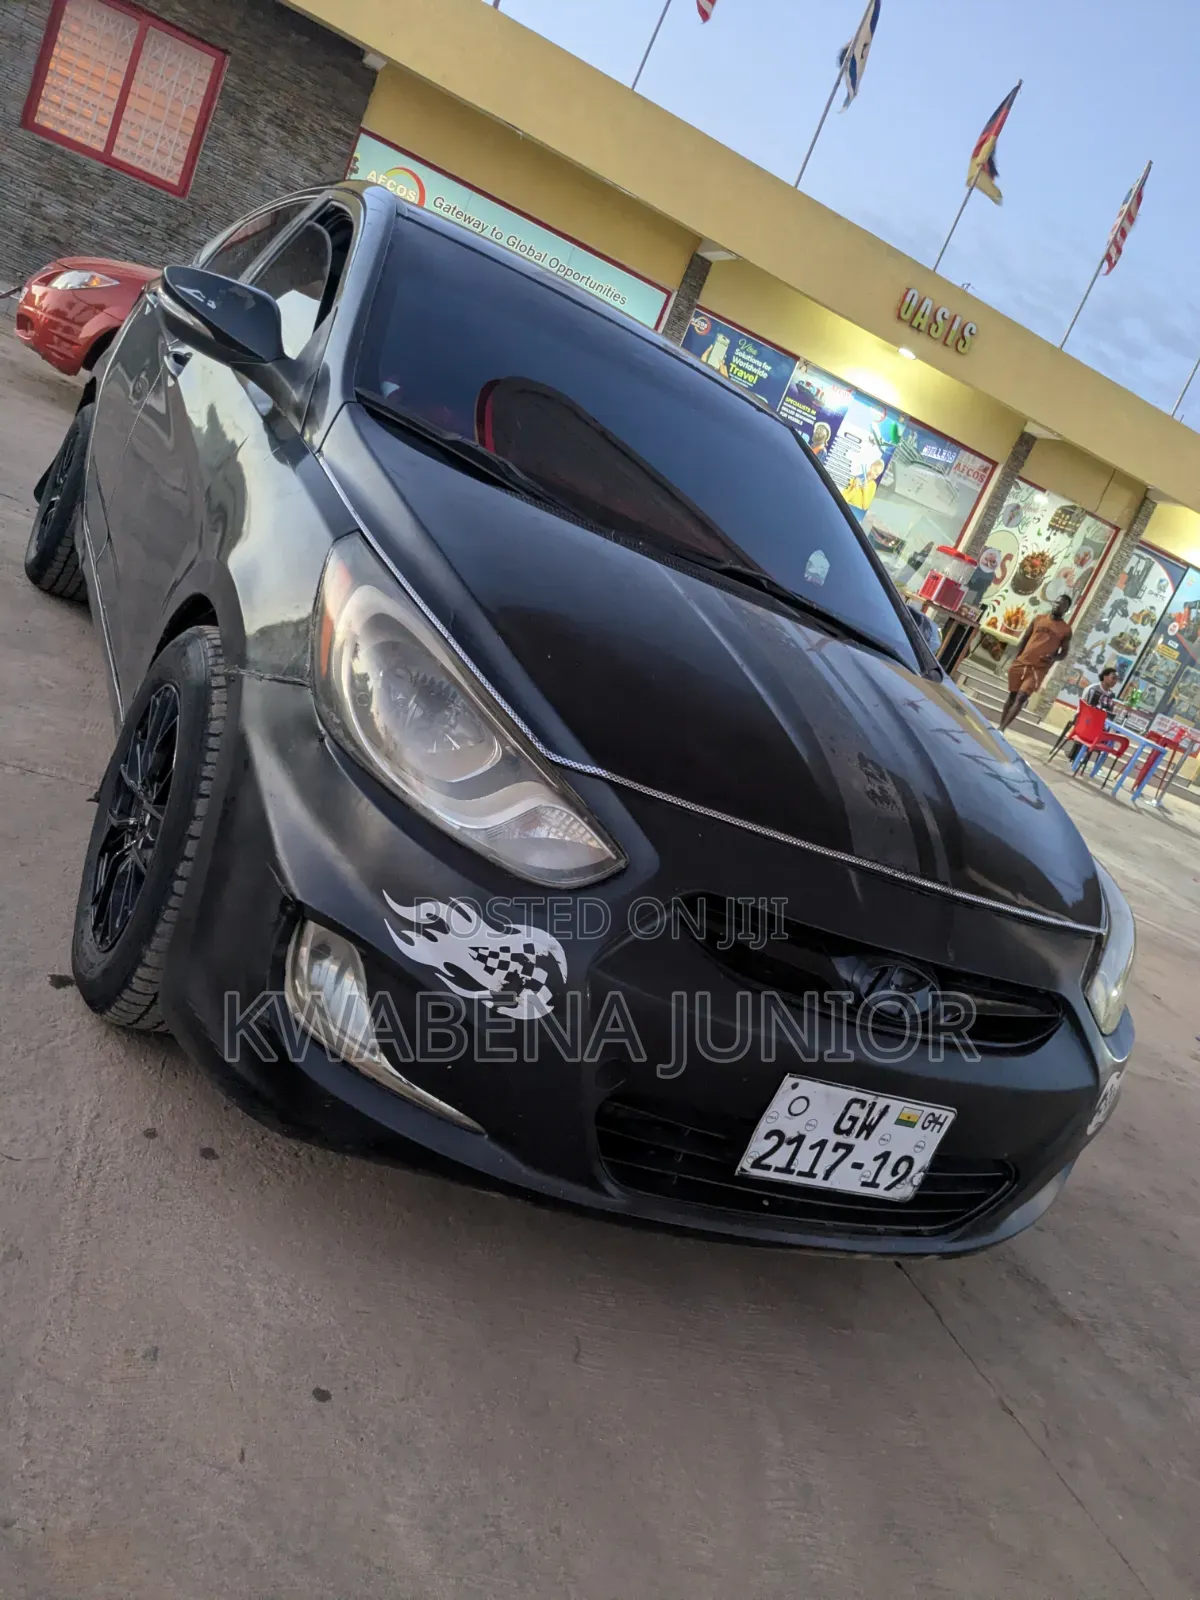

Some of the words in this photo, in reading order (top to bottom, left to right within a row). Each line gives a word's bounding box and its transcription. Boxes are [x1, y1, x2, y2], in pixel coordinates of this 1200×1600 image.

[366, 169, 417, 201] AFCOS
[432, 195, 489, 233] Gateway
[490, 224, 504, 241] to
[506, 234, 548, 264] Global
[547, 256, 628, 306] Opportunities
[897, 287, 977, 354] OASIS
[729, 362, 759, 385] Travel
[731, 356, 768, 379] Worldwide
[734, 349, 764, 366] Solutions
[762, 361, 772, 372] for
[954, 462, 986, 483] AFCOS
[833, 1097, 890, 1141] GW
[921, 1112, 948, 1134] GH
[750, 1129, 915, 1192] 2117-19
